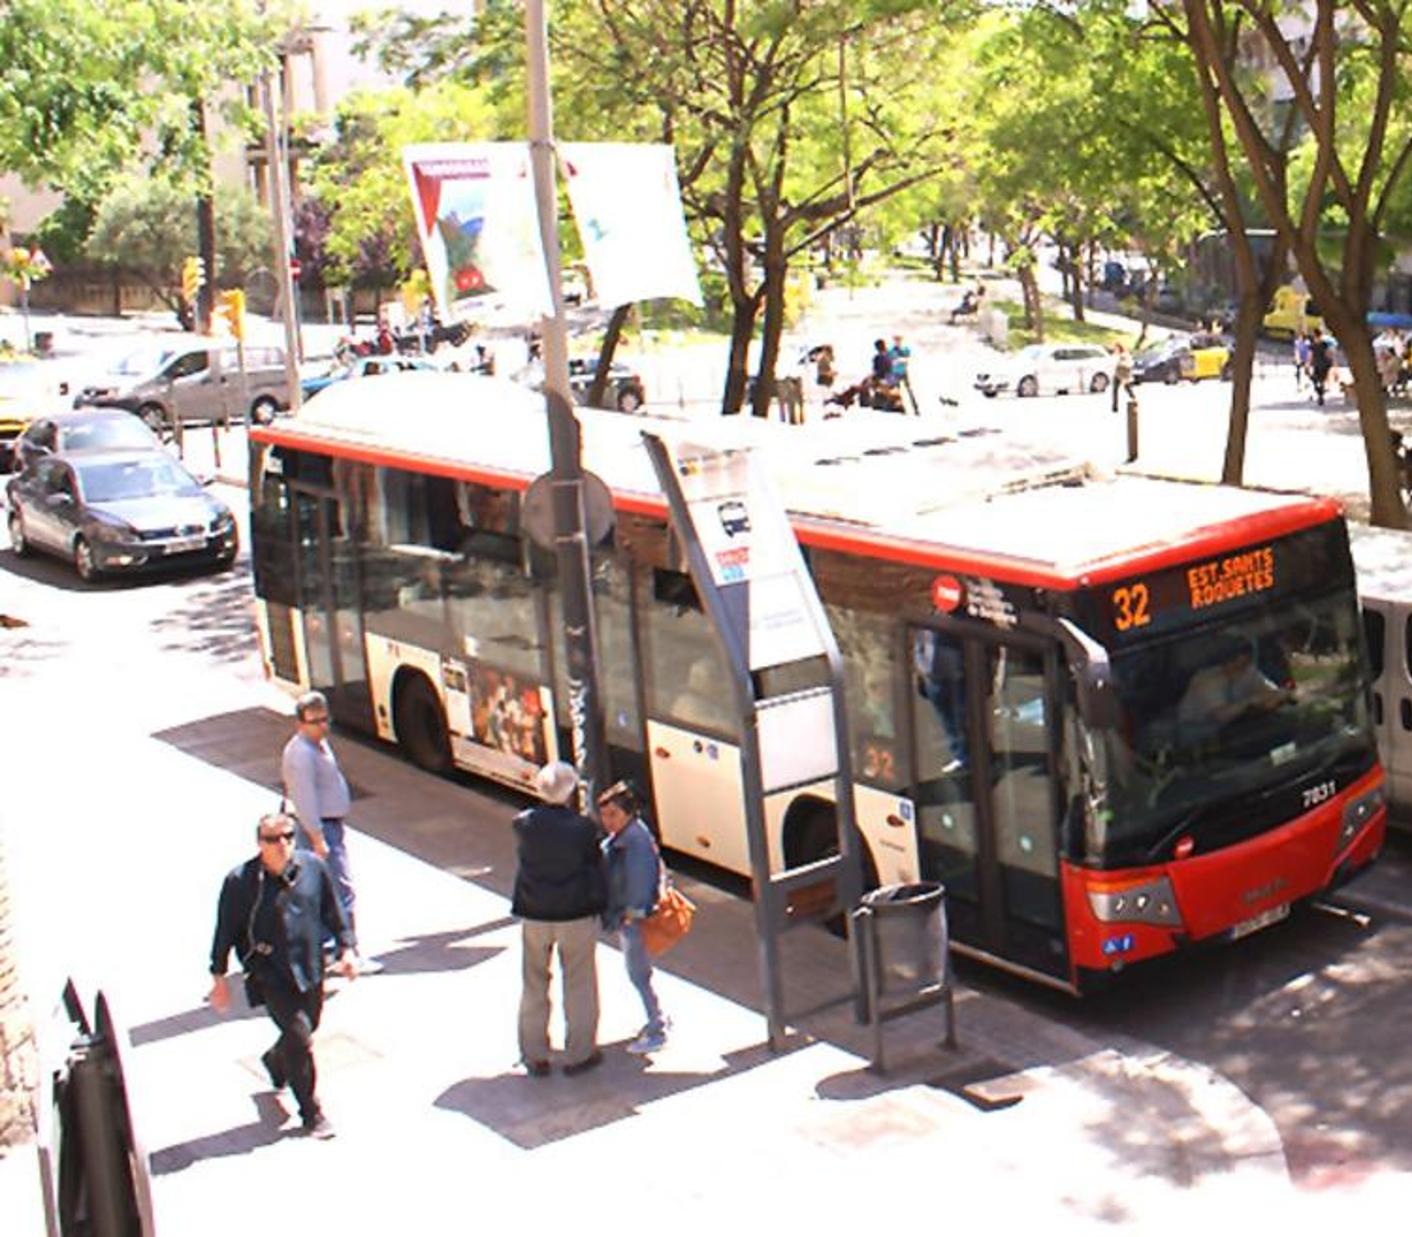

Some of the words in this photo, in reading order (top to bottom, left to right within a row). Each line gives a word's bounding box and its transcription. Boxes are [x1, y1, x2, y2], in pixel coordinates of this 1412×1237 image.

[1113, 583, 1151, 631] 32
[1190, 570, 1274, 610] ROQUETES
[863, 744, 896, 783] 32
